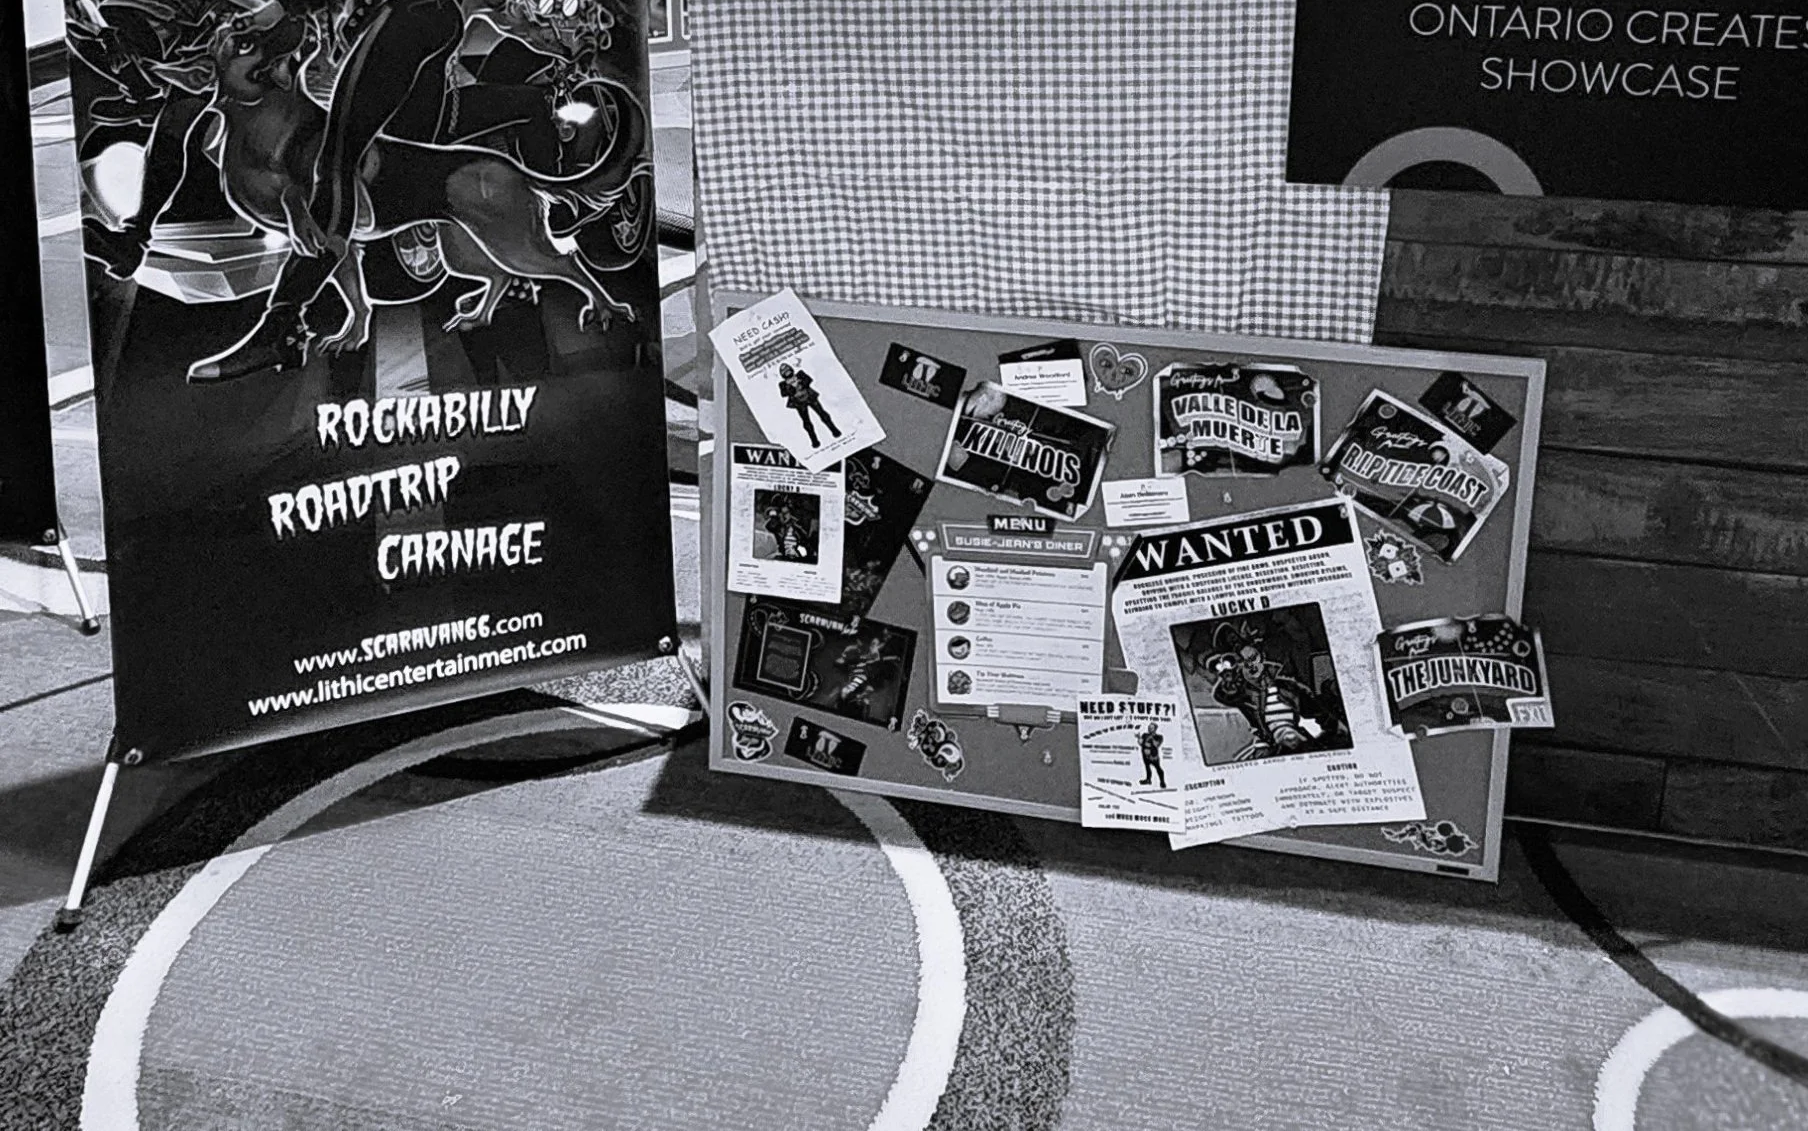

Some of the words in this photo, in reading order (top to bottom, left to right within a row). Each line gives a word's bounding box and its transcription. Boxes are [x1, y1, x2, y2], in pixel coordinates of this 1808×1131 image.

[1409, 3, 1614, 43] ONTARIO
[1626, 10, 1808, 50] CREATE
[1480, 57, 1741, 101] SHOWCASE
[733, 327, 760, 345] NEED
[762, 311, 790, 330] CASH?
[316, 385, 537, 448] ROCKABILLY
[1171, 393, 1237, 426] VALLE
[1238, 401, 1270, 432] DE
[1272, 411, 1303, 436] LA
[961, 422, 1081, 486] KILLINOIS
[1191, 419, 1284, 462] MUERTE
[267, 455, 461, 539] ROADTRIP
[1423, 464, 1489, 507] COAST
[994, 518, 1046, 531] MENU
[1045, 541, 1083, 551] DINER
[1135, 515, 1323, 572] WANTED
[377, 521, 546, 581] CARNAGE
[1211, 597, 1257, 617] LUCKY
[1260, 596, 1270, 609] D
[248, 632, 587, 716] www.lithicentertainment.com
[1388, 662, 1428, 702] THE
[1428, 656, 1537, 695] JUNKYARD
[1080, 701, 1115, 714] NEED
[1515, 704, 1547, 722] EXIT
[1184, 778, 1225, 790] ESCRIPTION
